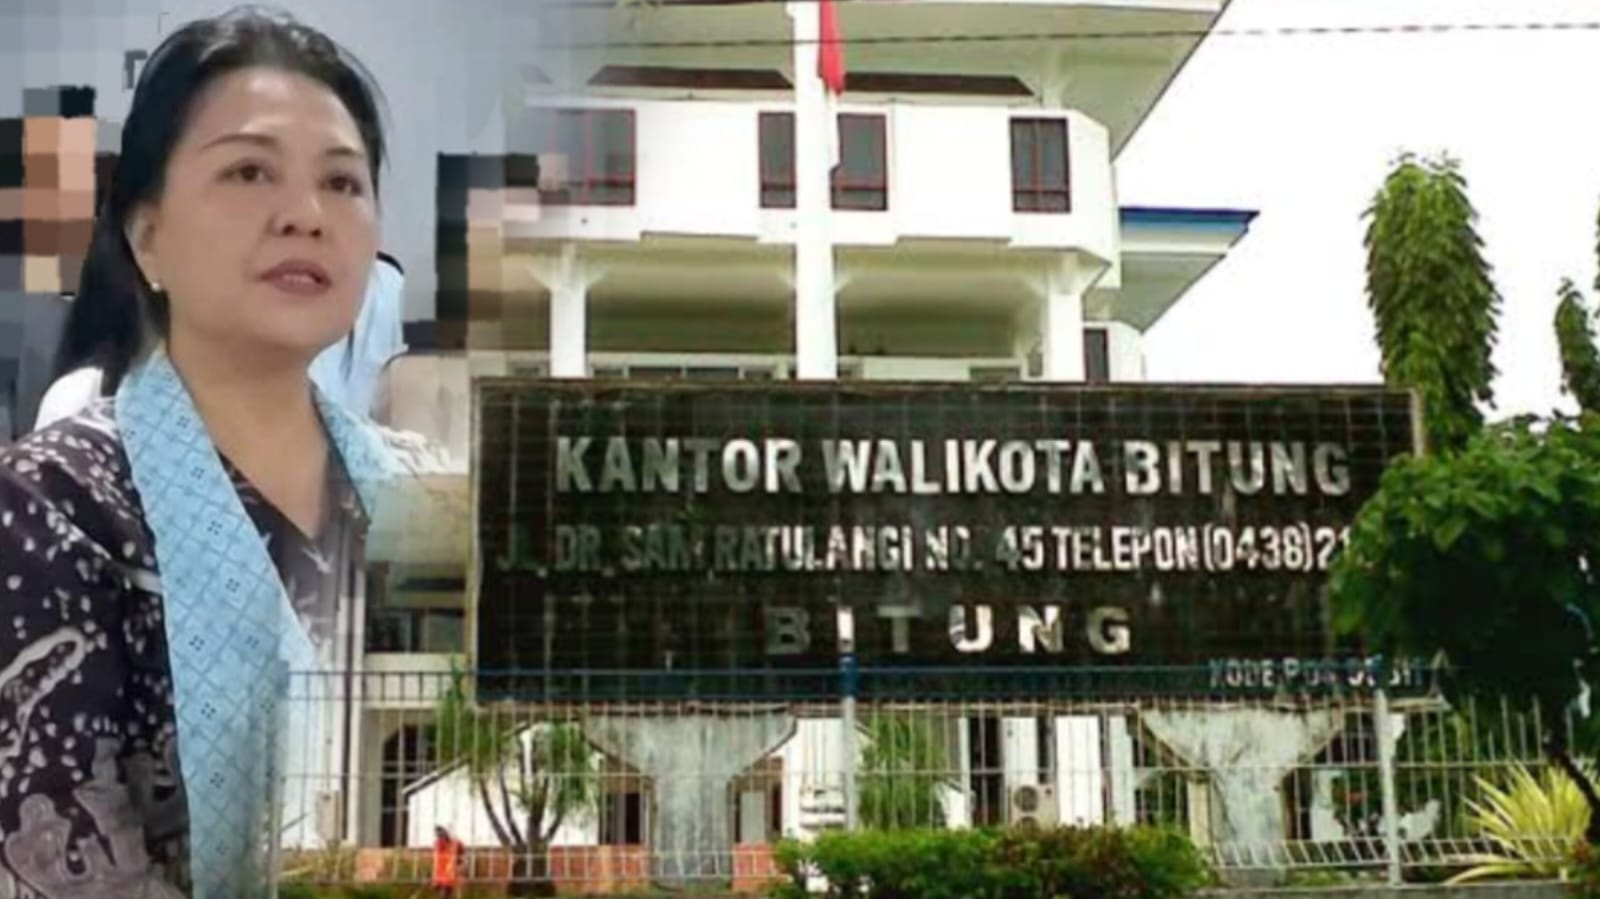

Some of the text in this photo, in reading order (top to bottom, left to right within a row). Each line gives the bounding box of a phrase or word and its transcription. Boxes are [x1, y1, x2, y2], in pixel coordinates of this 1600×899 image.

[556, 436, 1351, 496] KANTOR WALIKOTA BITUNG
[714, 524, 913, 571] RATULANGI
[996, 525, 1044, 571] 45
[1051, 525, 1199, 571] TELEPON
[764, 605, 1132, 654] BITUNG
